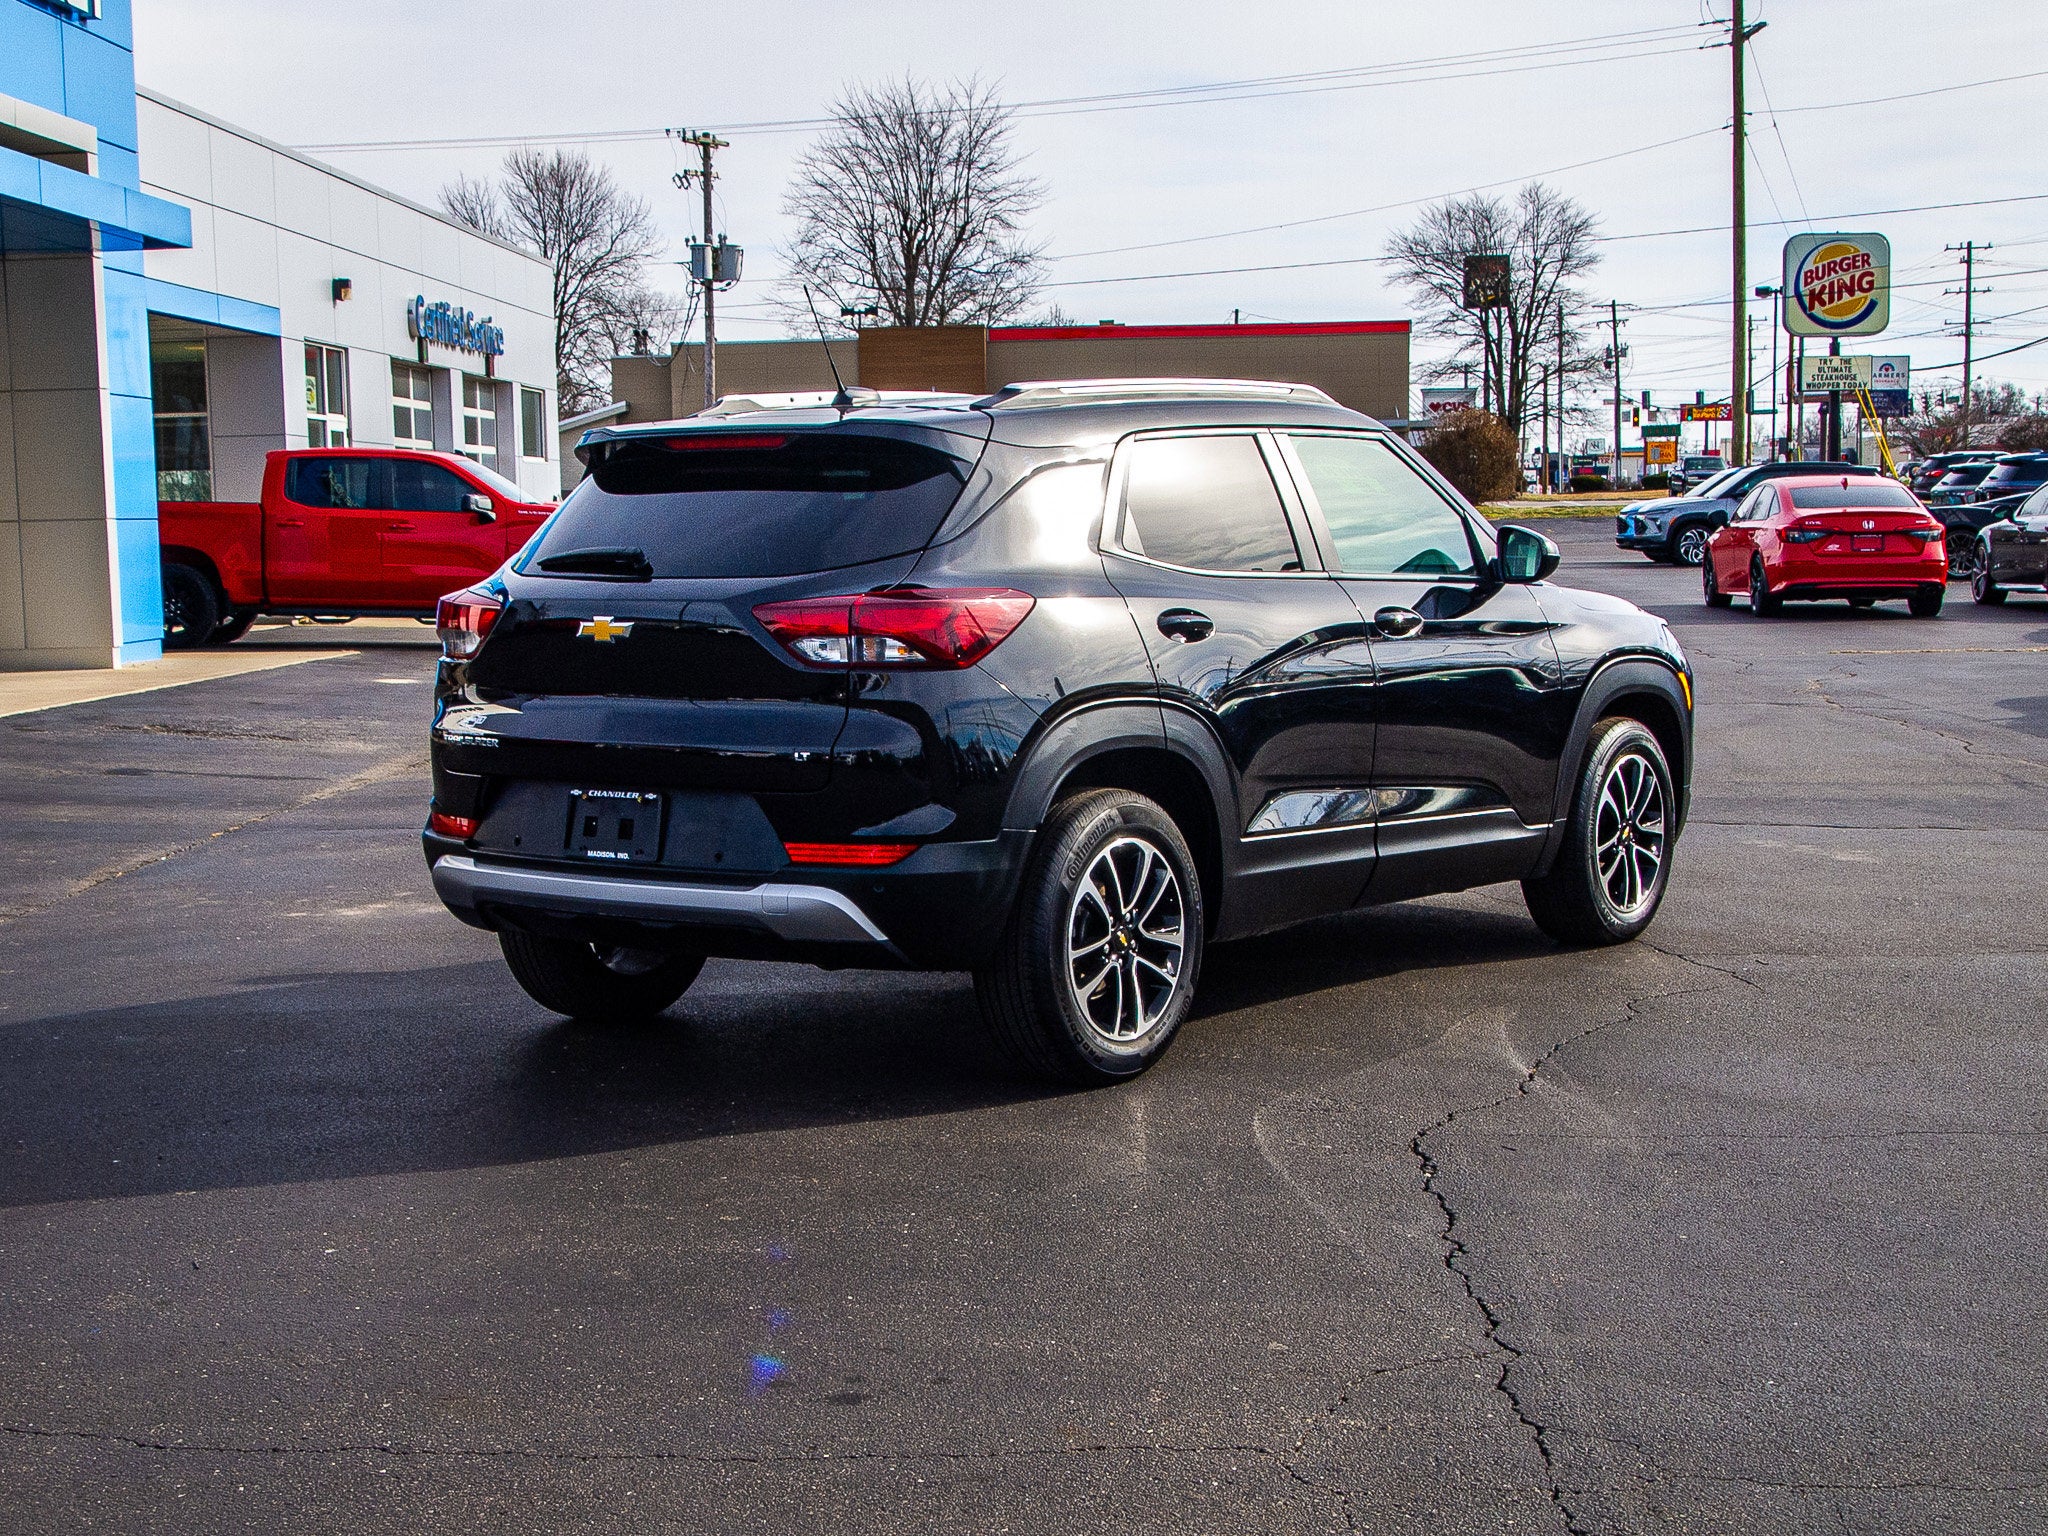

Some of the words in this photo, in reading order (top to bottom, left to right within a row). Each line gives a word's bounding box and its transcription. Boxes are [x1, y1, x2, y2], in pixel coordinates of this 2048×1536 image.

[1803, 252, 1872, 288] BURGER
[1808, 270, 1876, 312] KING
[415, 294, 464, 348] Certified
[466, 310, 504, 356] Service
[1819, 358, 1833, 366] TRY
[1811, 374, 1857, 382] STEAKHOUSE
[794, 752, 810, 762] LT
[588, 790, 639, 799] CHANDLER
[1067, 816, 1112, 881] Continental
